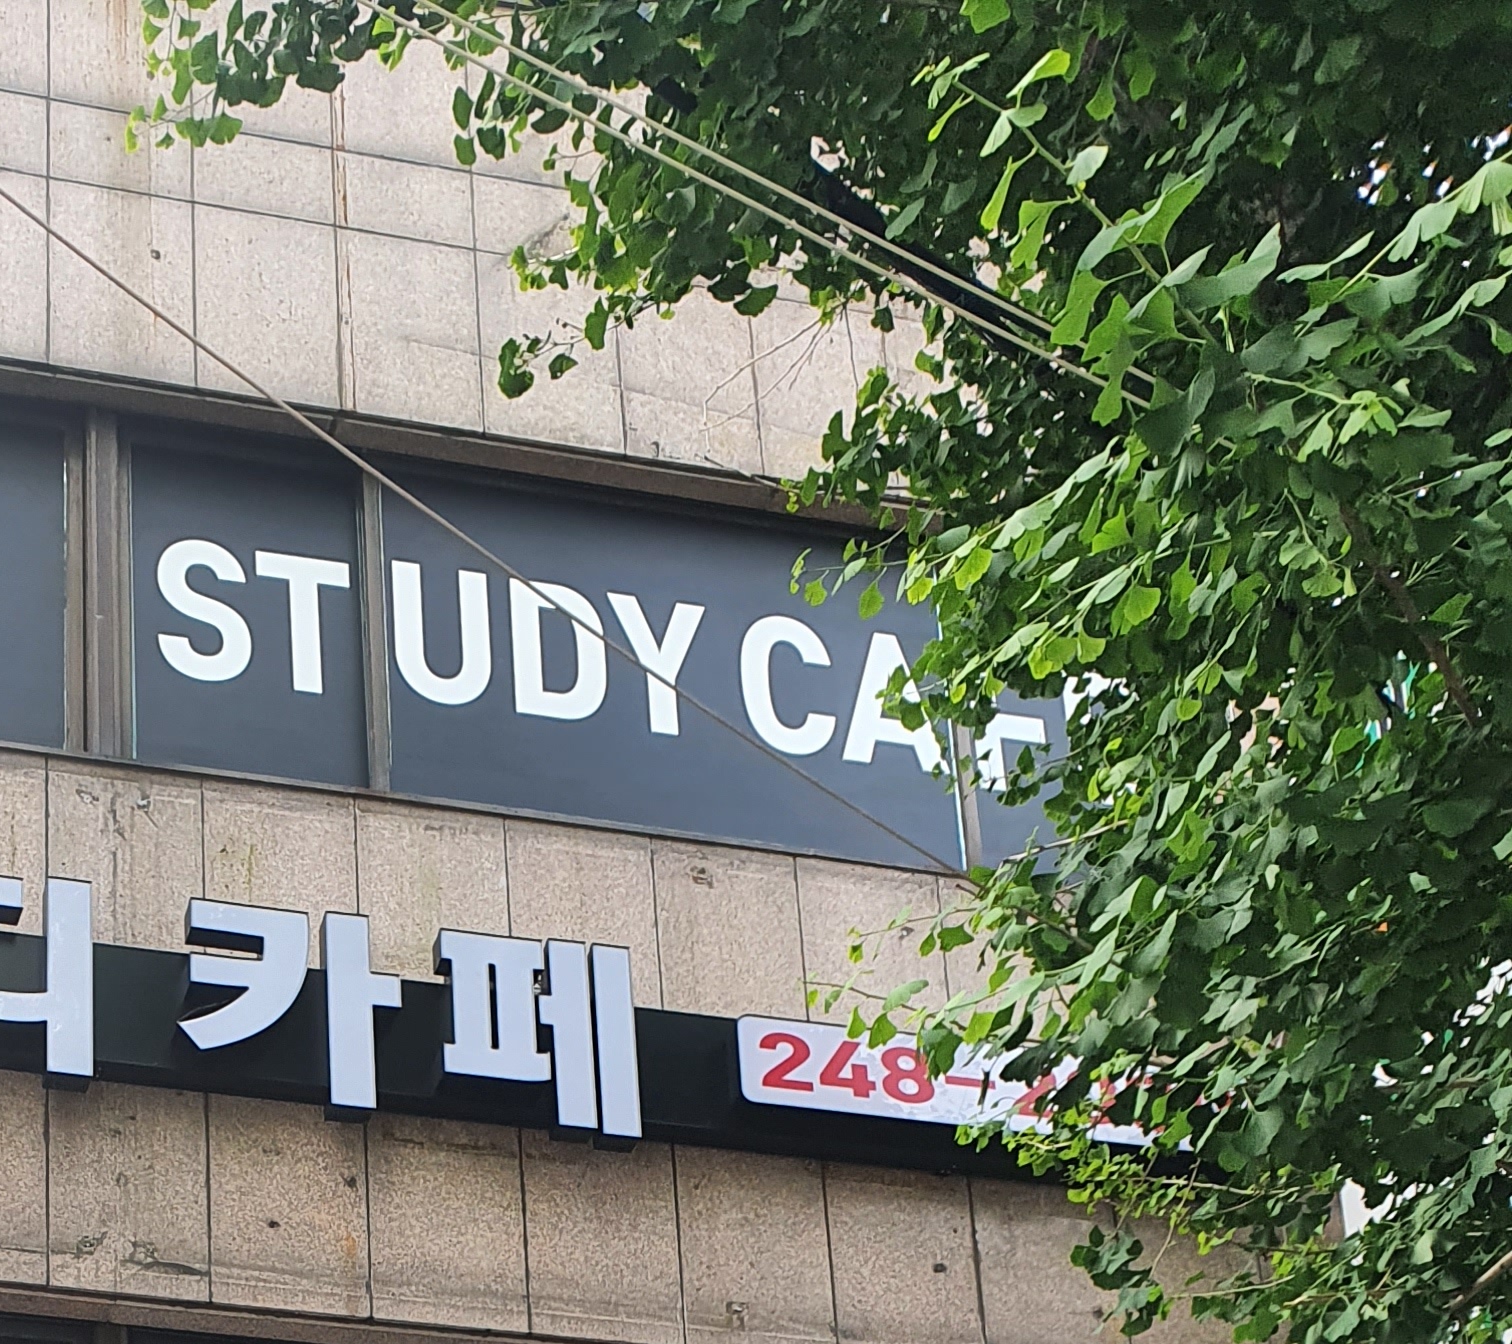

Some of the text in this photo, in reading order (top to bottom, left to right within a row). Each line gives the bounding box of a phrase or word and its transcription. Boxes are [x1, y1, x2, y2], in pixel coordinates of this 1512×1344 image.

[156, 538, 707, 737] STUDY
[738, 614, 1140, 810] CAF
[178, 895, 641, 1140] 카페
